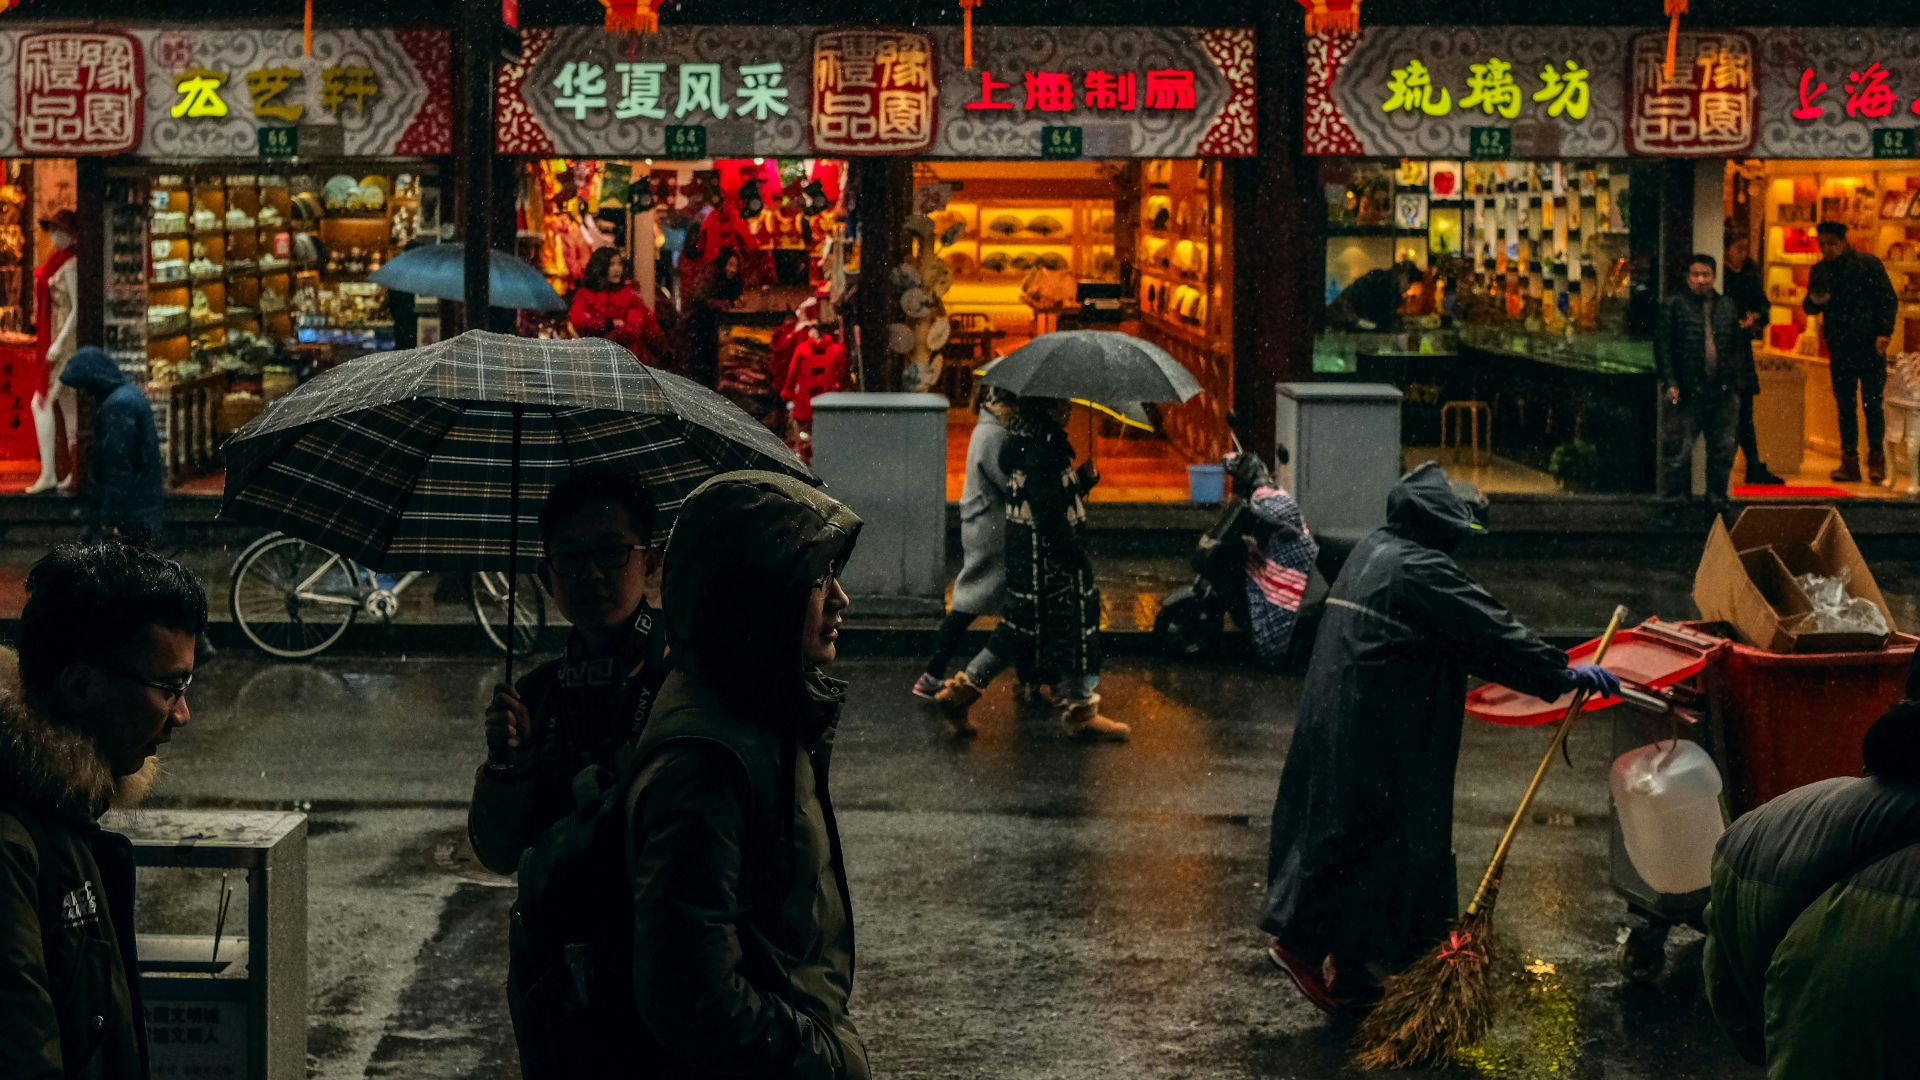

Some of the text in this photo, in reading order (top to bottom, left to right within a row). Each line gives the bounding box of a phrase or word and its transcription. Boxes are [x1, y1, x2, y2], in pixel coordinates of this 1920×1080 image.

[171, 65, 378, 121] 宏艺轩
[553, 61, 789, 121] 华夏风采
[965, 68, 1196, 112] 上海制扇
[1382, 57, 1590, 120] 琉璃坊
[1792, 62, 1920, 120] 上海
[268, 130, 288, 146] 66
[675, 128, 696, 144] 64
[1051, 129, 1072, 146] 64
[1479, 129, 1502, 147] 62
[1883, 130, 1905, 148] 62
[631, 687, 651, 733] SONY
